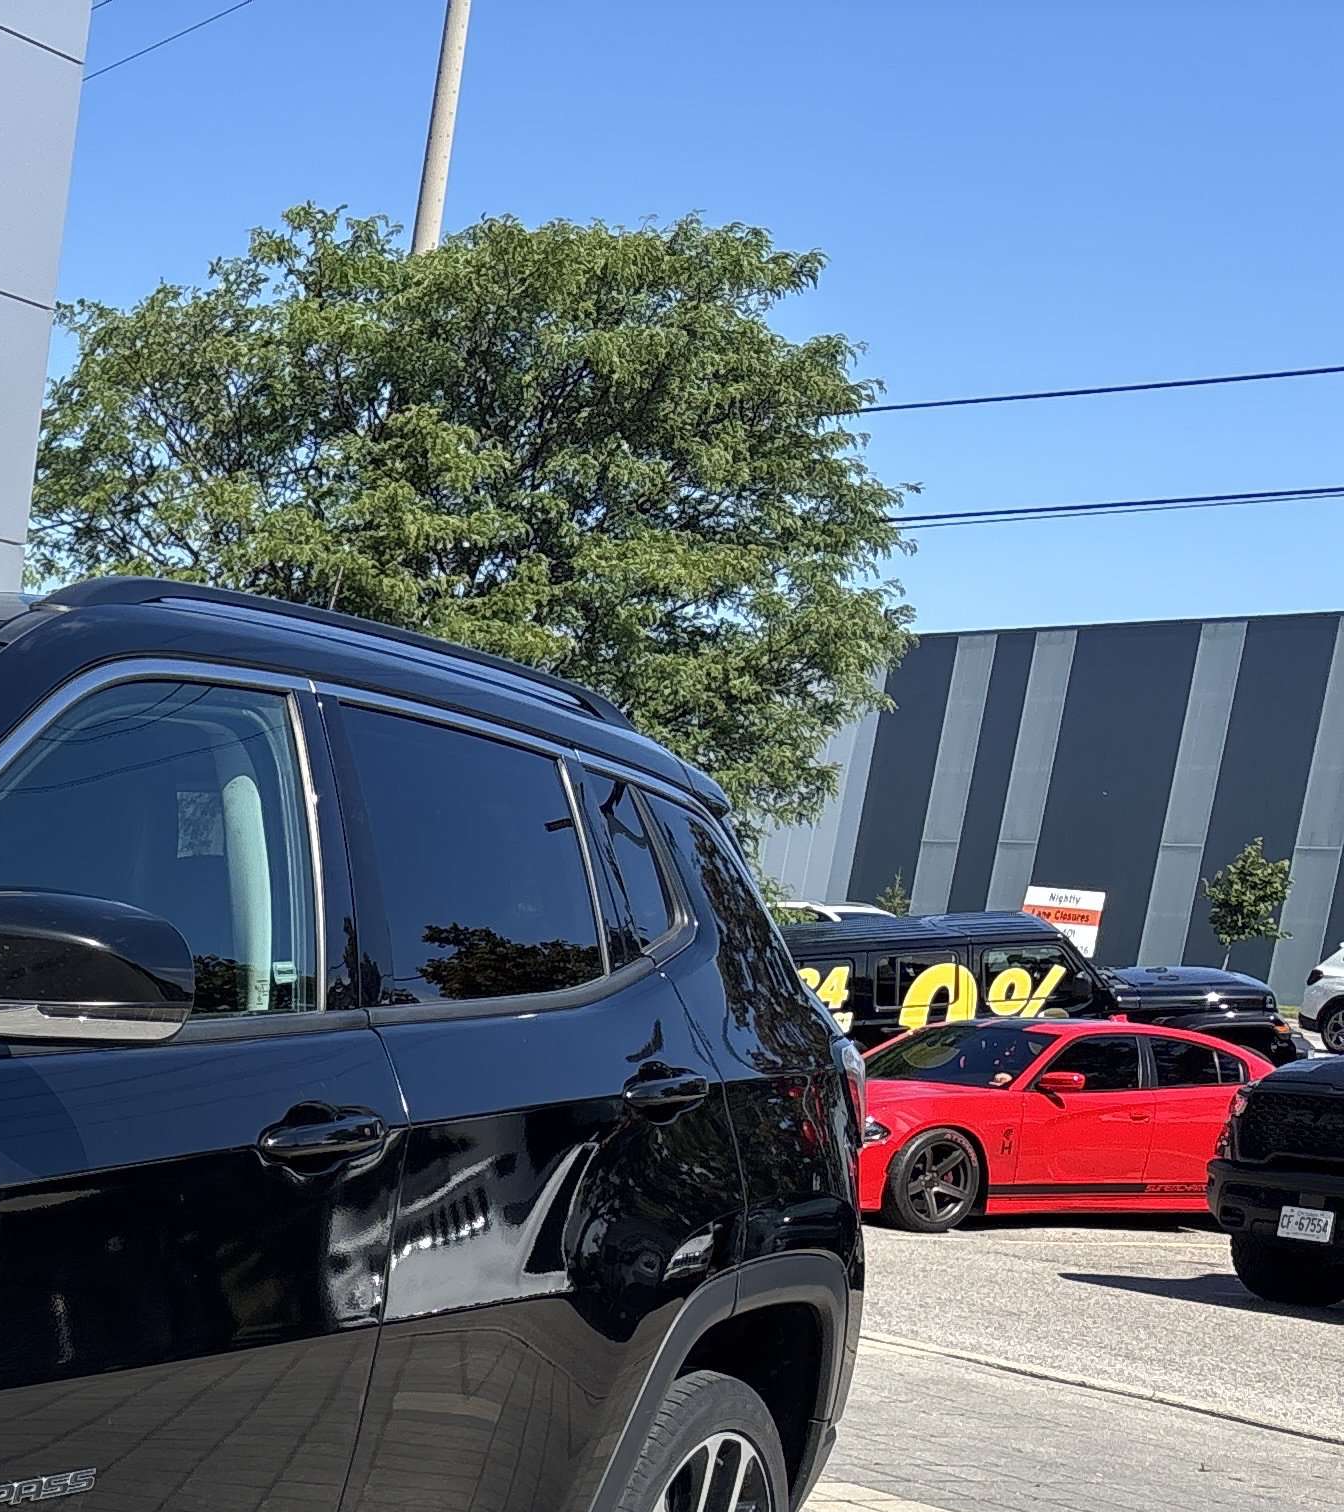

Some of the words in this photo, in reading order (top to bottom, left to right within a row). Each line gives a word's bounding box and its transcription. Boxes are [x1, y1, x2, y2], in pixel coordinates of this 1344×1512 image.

[1049, 892, 1081, 905] Nightly
[1054, 909, 1091, 923] Closures
[1280, 1214, 1294, 1229] CF
